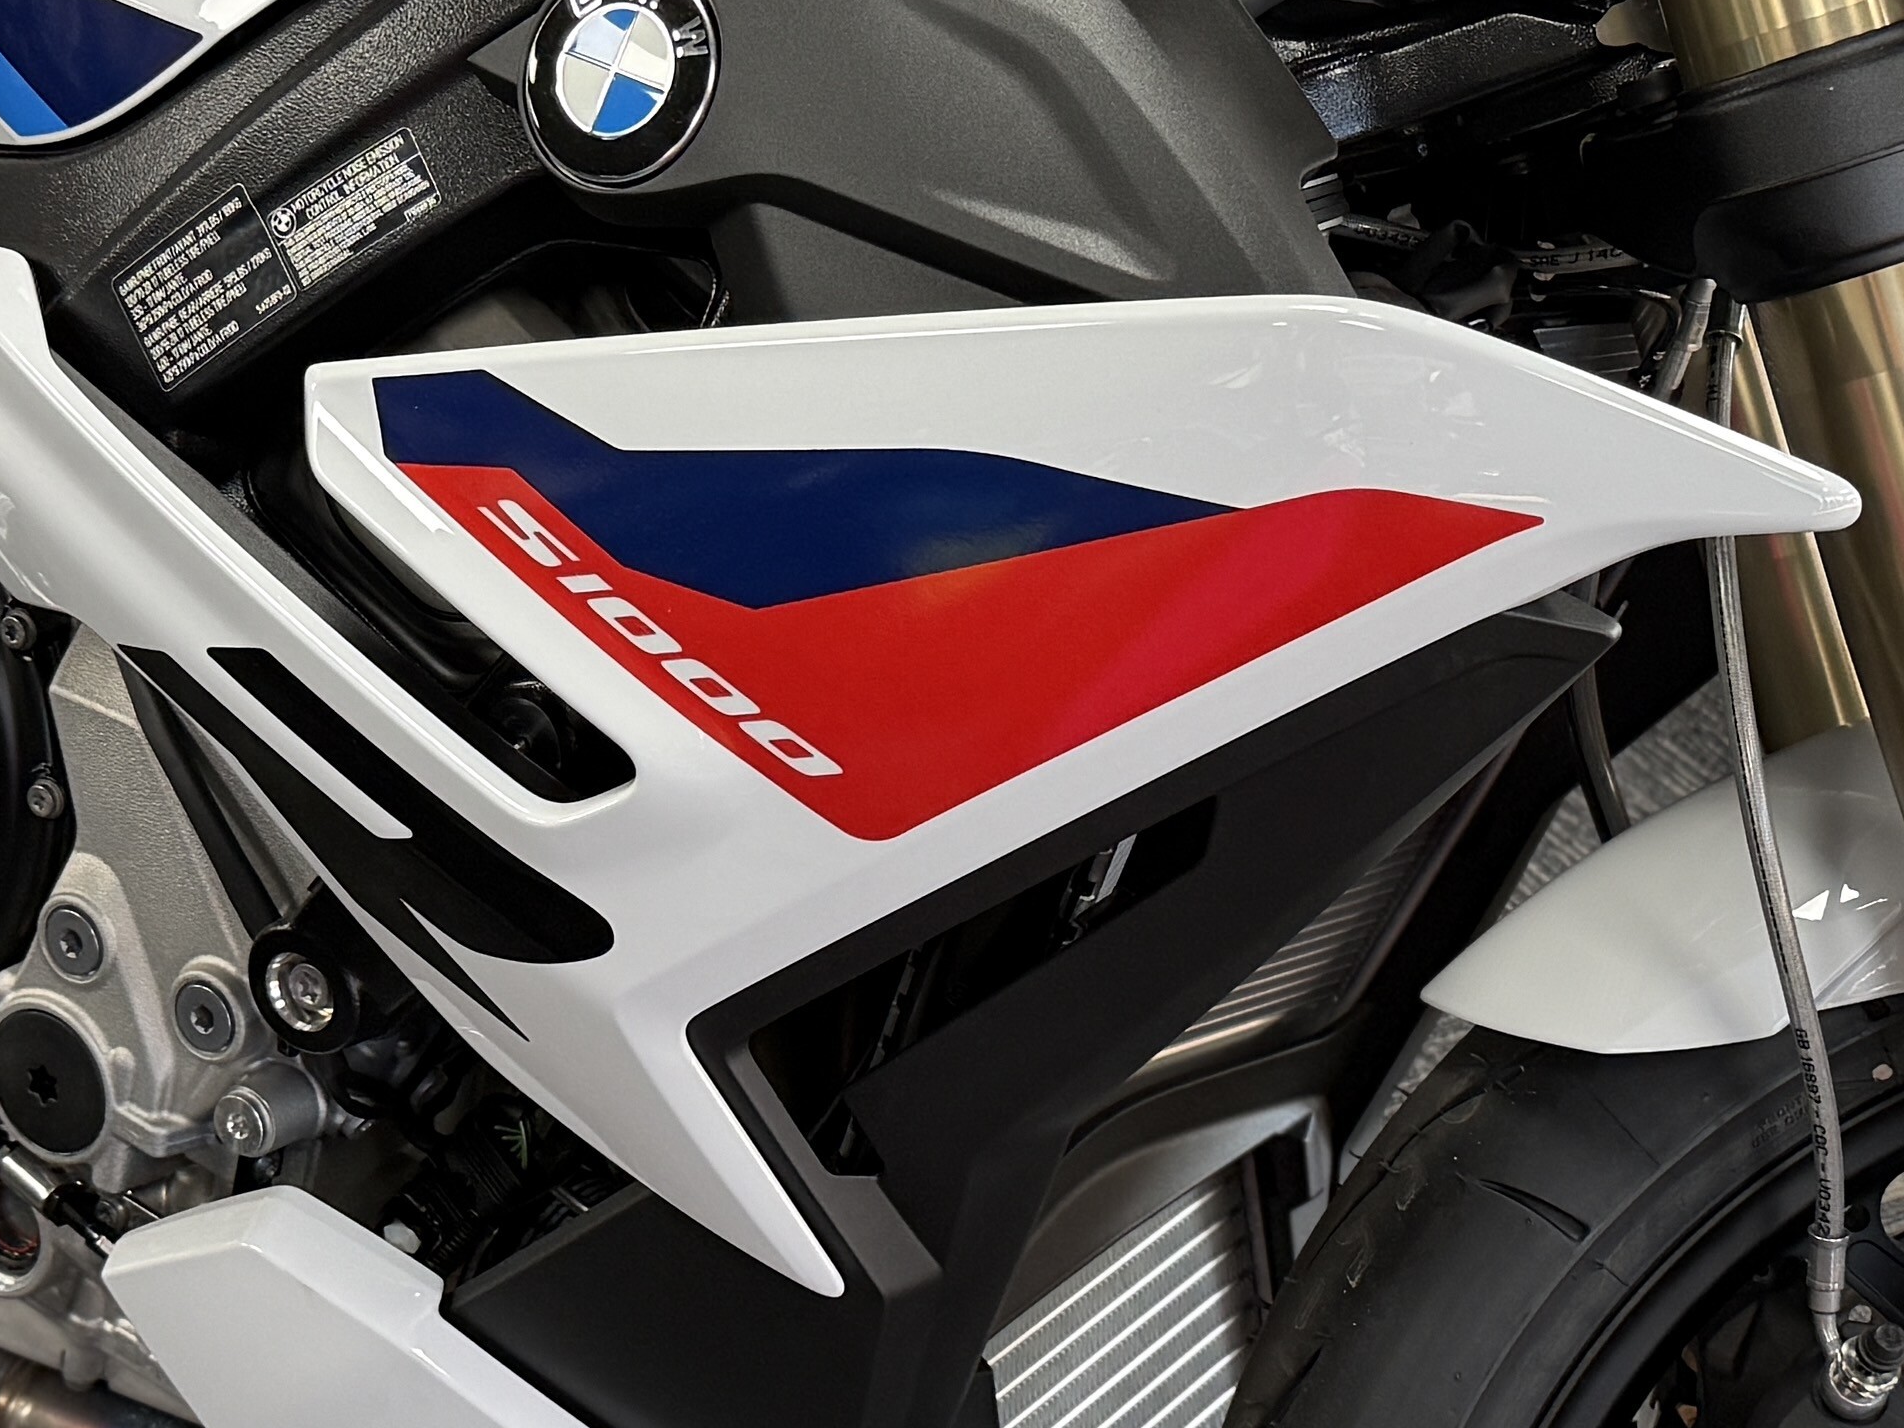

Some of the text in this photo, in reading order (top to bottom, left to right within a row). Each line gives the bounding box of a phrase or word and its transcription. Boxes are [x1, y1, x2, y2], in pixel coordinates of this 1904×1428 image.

[290, 134, 404, 213] MOTORCYCLE NOISE EMISSION
[306, 152, 400, 220] CONTROL INFORMATION
[477, 498, 844, 777] S1000
[1796, 1027, 1811, 1052] GB
